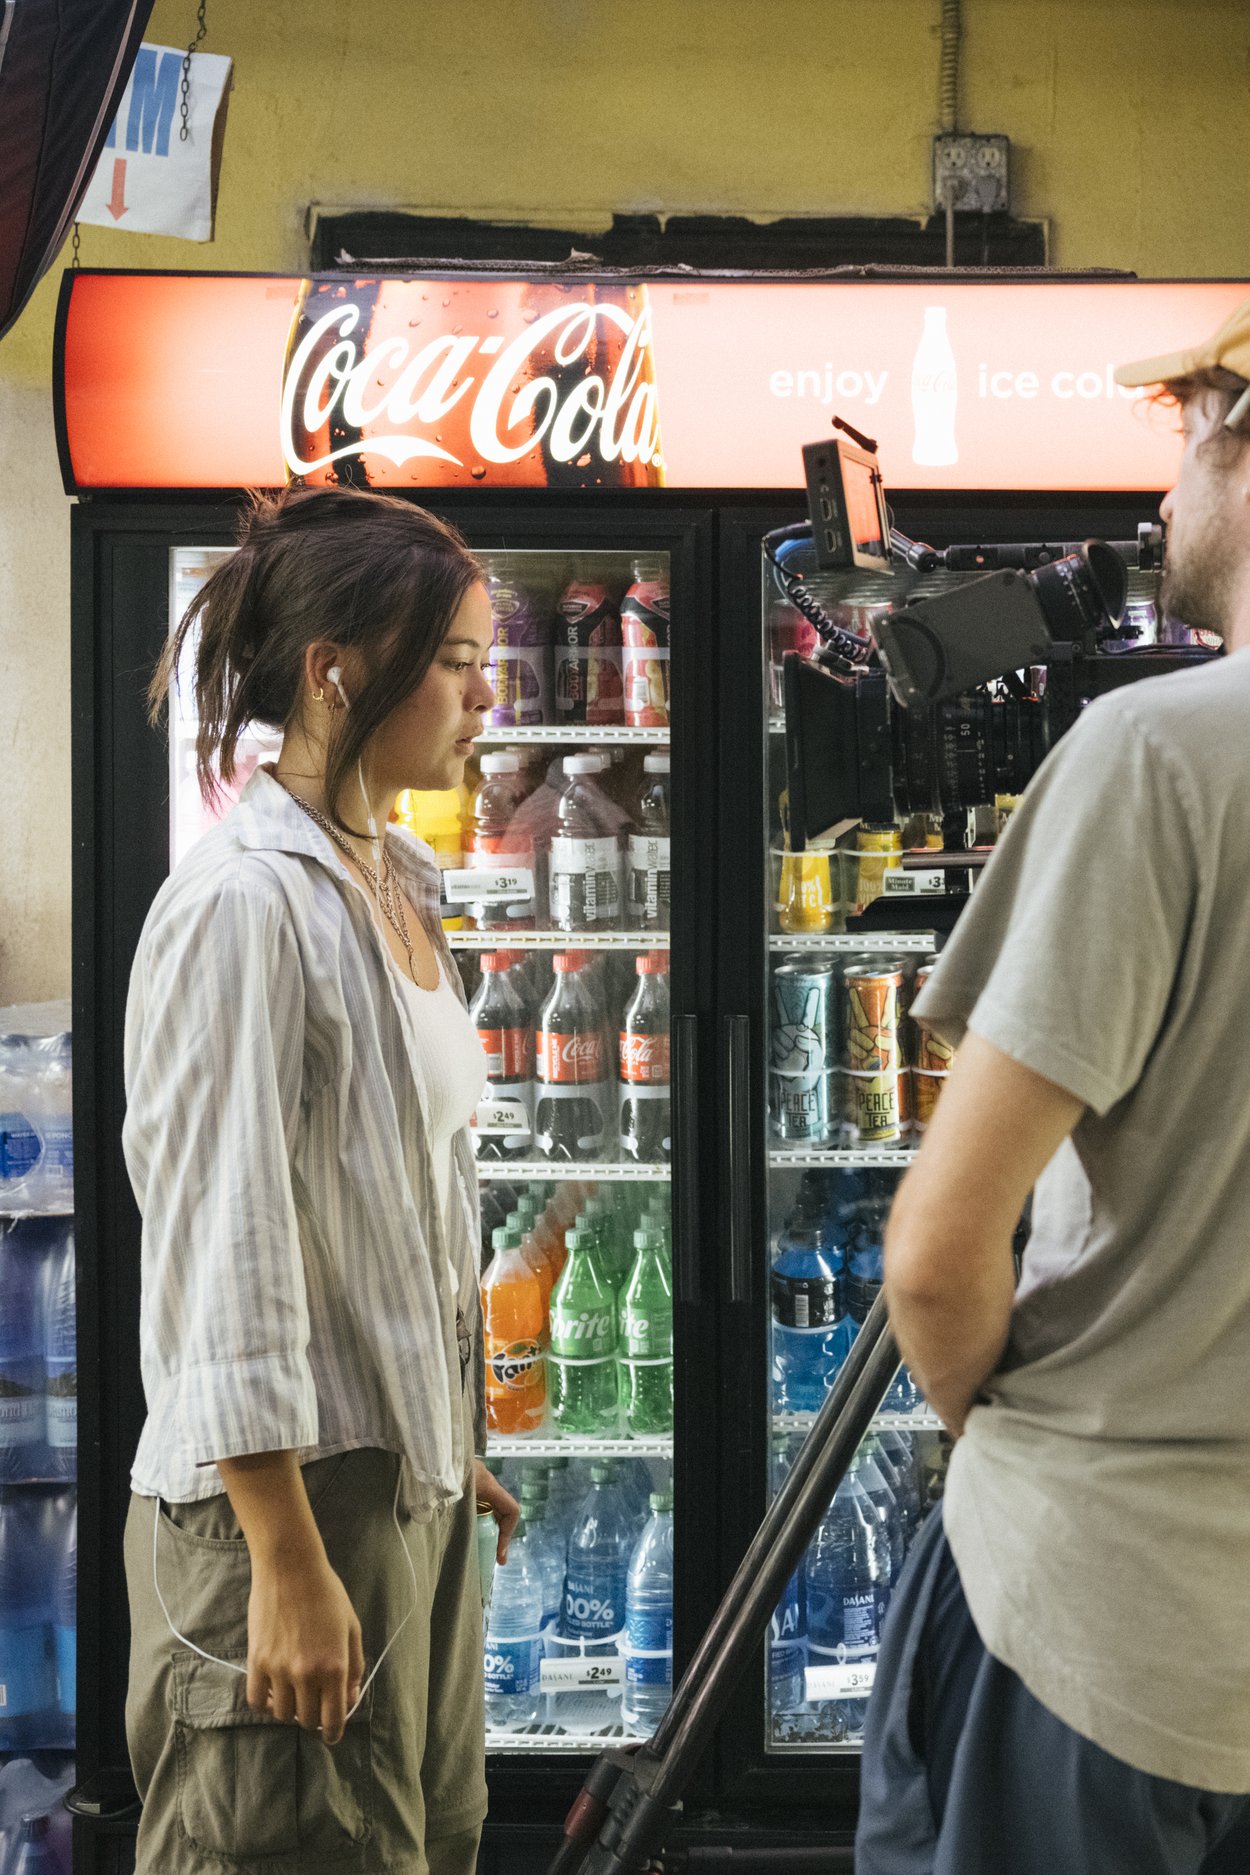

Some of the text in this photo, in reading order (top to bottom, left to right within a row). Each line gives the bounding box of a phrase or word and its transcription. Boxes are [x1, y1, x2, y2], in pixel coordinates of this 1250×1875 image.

[104, 48, 182, 157] M
[280, 302, 661, 476] Coca-Cola
[768, 362, 888, 405] enjoy
[978, 363, 1040, 399] ice
[497, 627, 509, 704] BODYAROR
[567, 626, 579, 701] BODYAROR
[860, 1091, 895, 1112] PEACE
[865, 1112, 890, 1127] TEA
[491, 1344, 541, 1384] Fant
[843, 1594, 875, 1606] DASANI
